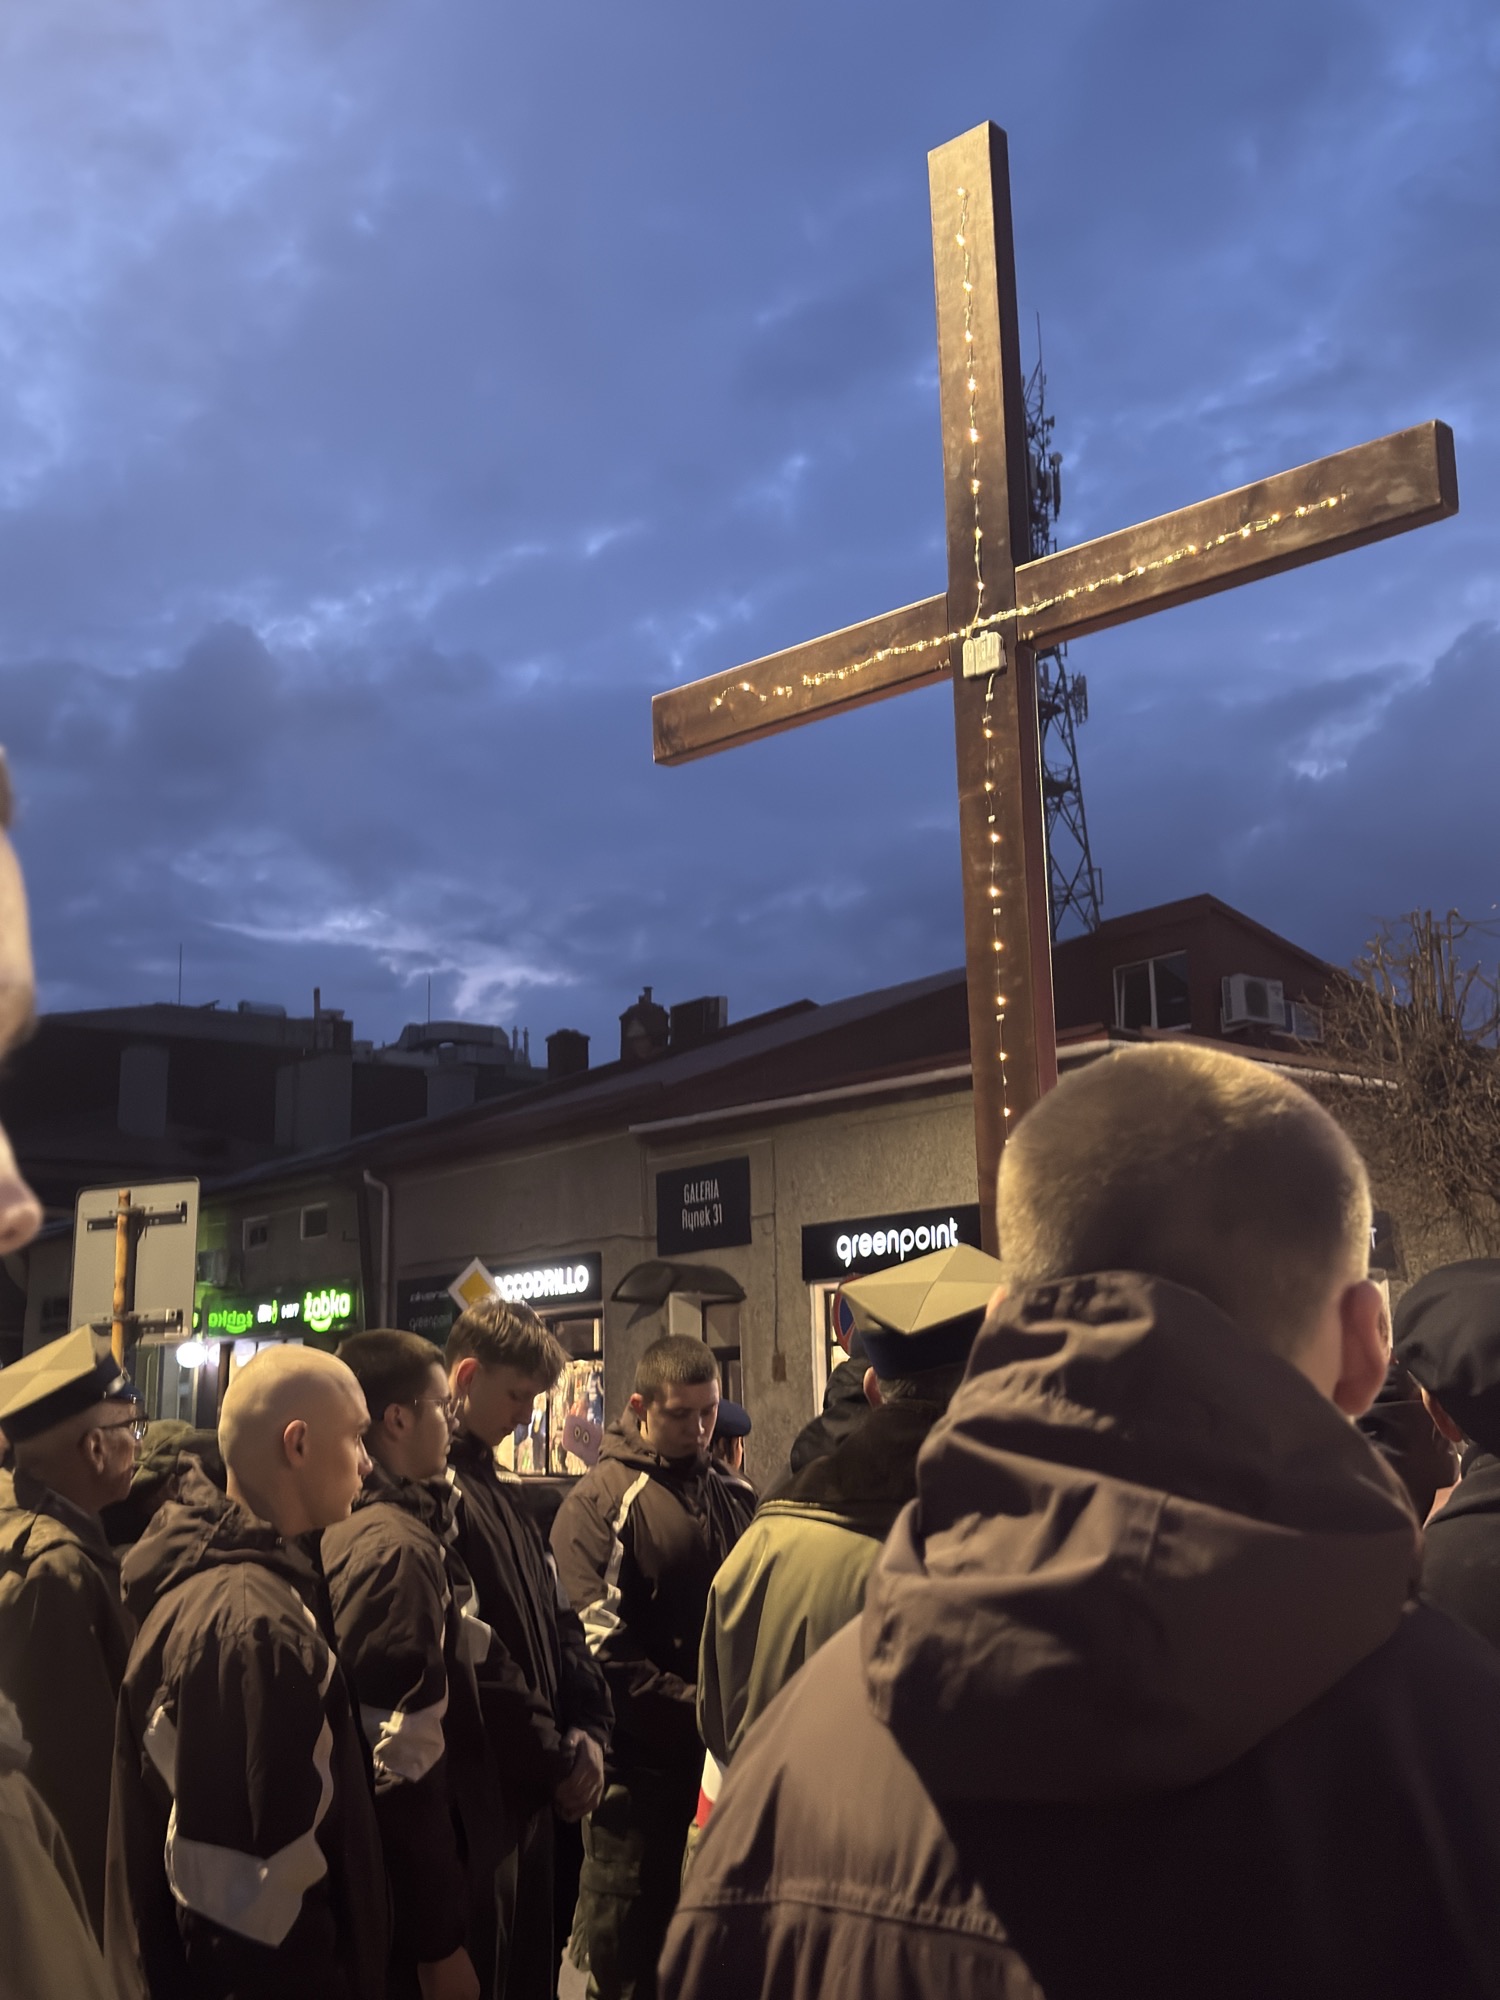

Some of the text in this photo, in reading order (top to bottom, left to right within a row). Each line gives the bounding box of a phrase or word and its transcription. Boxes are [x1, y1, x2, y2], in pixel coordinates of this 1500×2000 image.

[683, 1178, 719, 1205] GALERIA
[681, 1203, 722, 1232] Rynek 31
[836, 1217, 958, 1268] greenpoint
[303, 1289, 350, 1323] żabka
